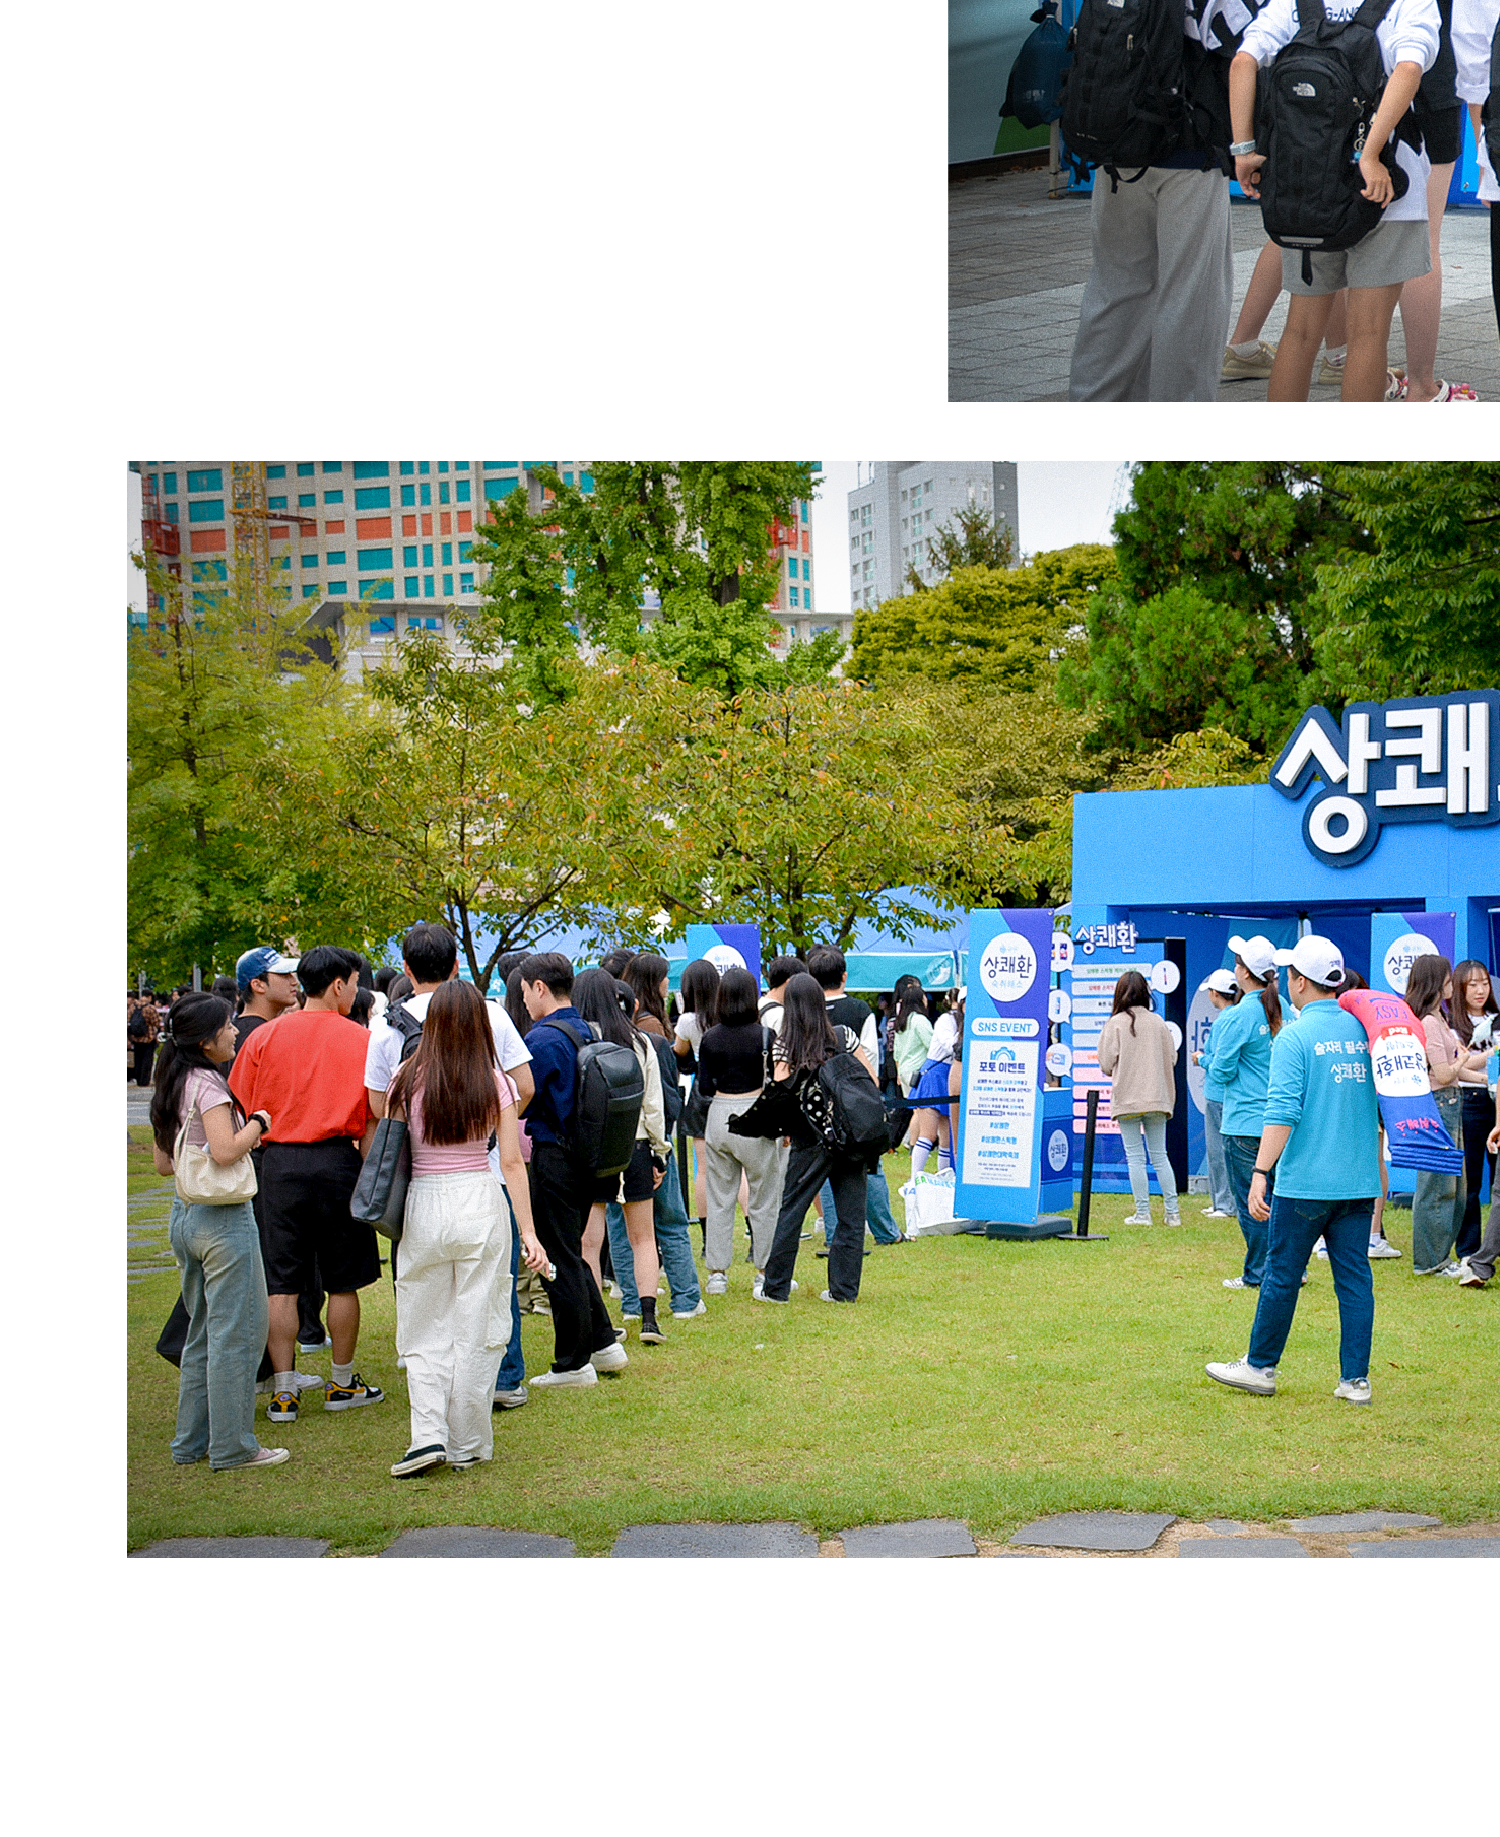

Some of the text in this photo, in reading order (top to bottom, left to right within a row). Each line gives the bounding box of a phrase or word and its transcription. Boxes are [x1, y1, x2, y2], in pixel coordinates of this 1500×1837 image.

[1075, 922, 1139, 955] 상쾌환
[984, 954, 1032, 979] 상쾌환
[1375, 1006, 1408, 1021] EASY
[978, 1022, 1032, 1033] SNS EVENT
[1388, 1027, 1408, 1036] Red
[1313, 1041, 1343, 1056] 술자리
[979, 1061, 1026, 1075] 포토 이벤트
[1330, 1061, 1367, 1084] 상쾌환
[1376, 1052, 1426, 1079] 상쾌환
